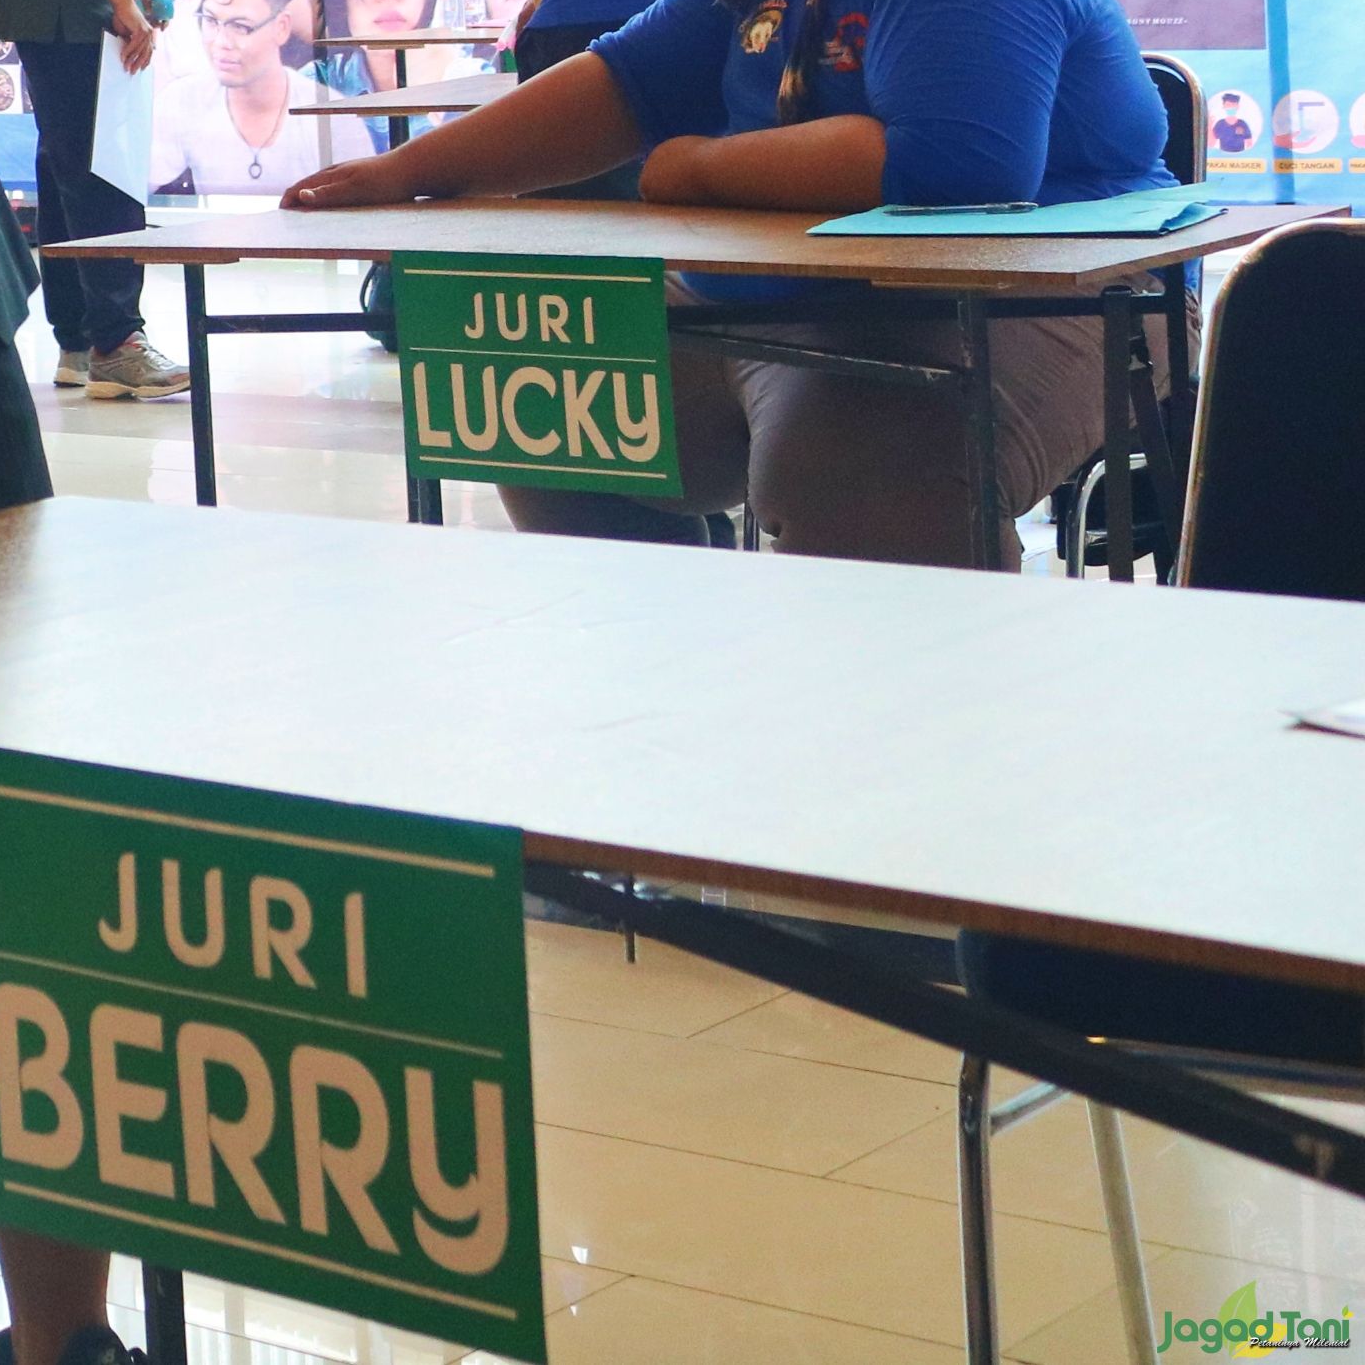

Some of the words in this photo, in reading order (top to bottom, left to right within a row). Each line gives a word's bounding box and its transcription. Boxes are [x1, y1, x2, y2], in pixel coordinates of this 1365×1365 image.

[1229, 162, 1262, 170] MASKER
[1300, 161, 1335, 170] TANGAN
[464, 291, 596, 345] JURI
[412, 360, 662, 463] LUCKY
[98, 851, 367, 999] JURI
